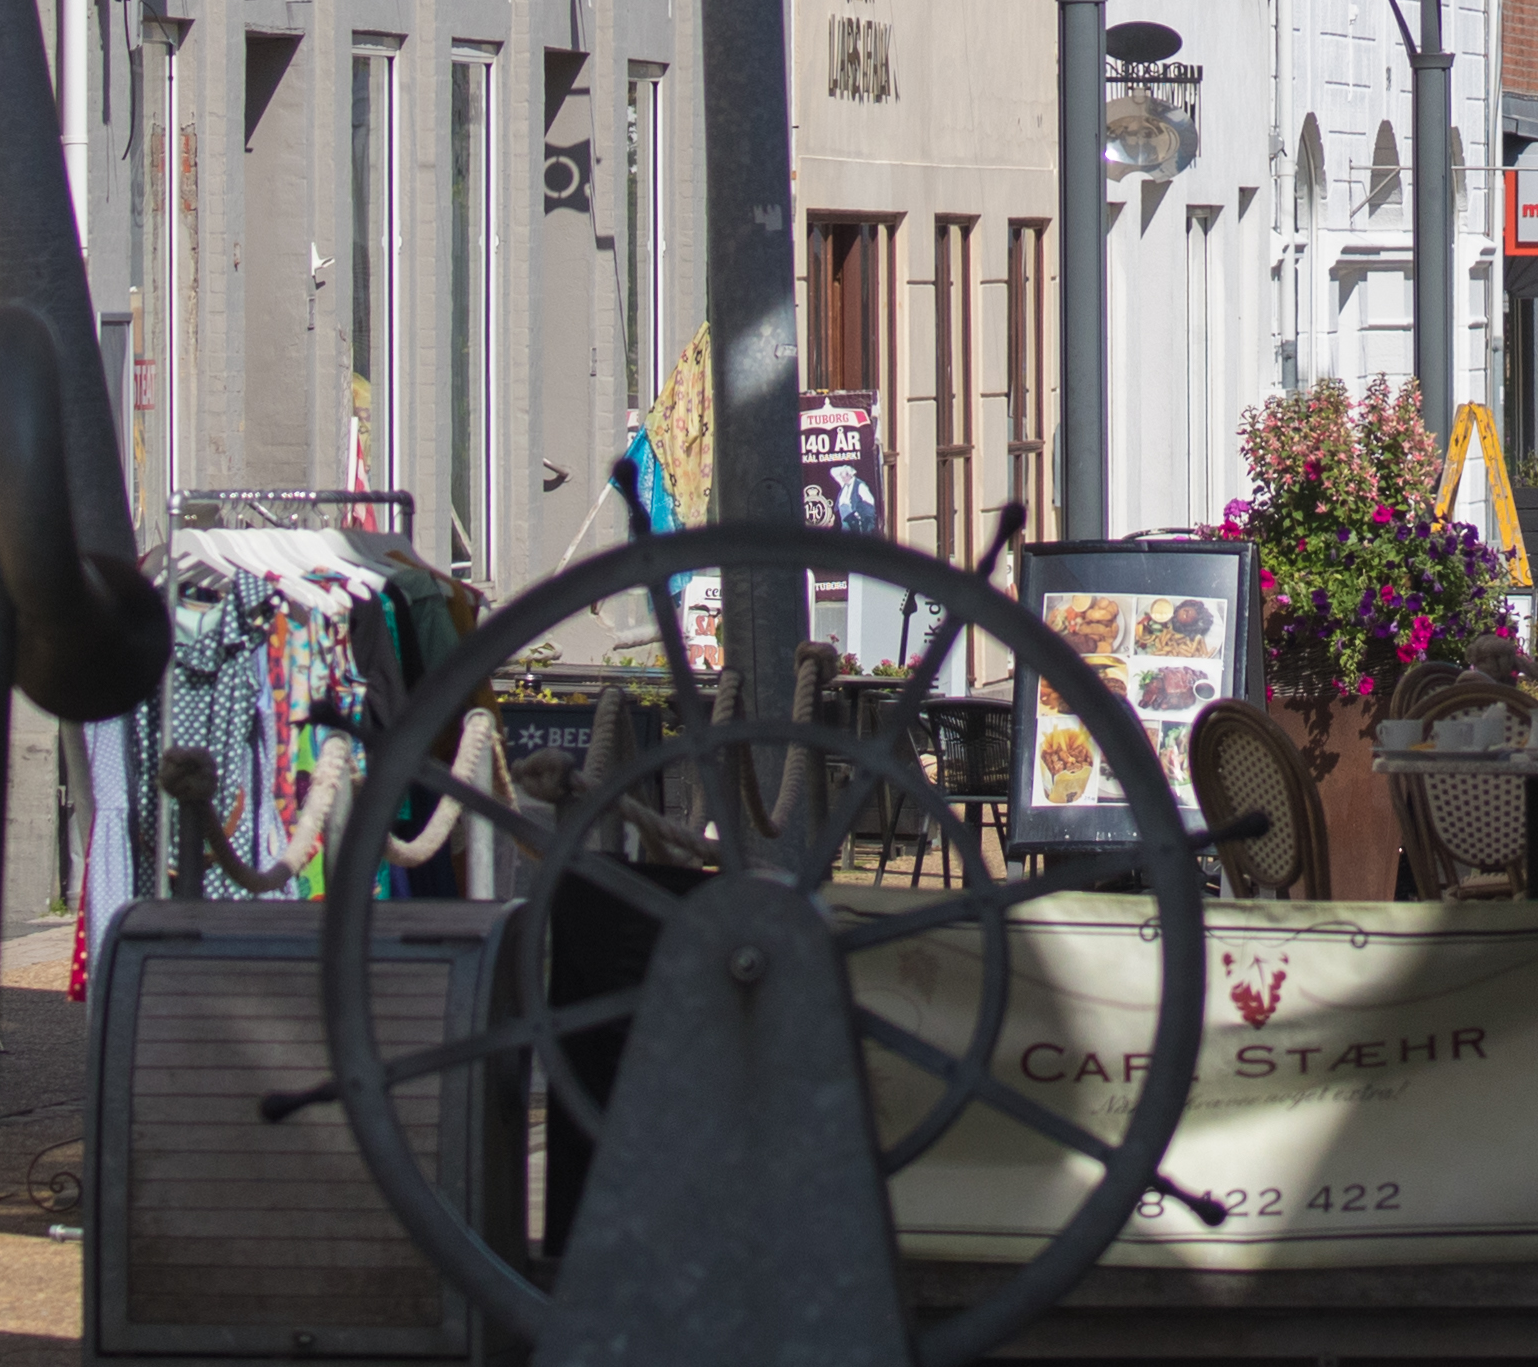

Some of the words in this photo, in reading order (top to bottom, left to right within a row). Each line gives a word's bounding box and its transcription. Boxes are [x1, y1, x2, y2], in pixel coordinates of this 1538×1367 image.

[808, 413, 850, 426] TUBORG
[835, 426, 862, 451] ÅR
[815, 581, 847, 592] TUBORG
[547, 727, 592, 748] BEE
[1020, 1042, 1200, 1083] CAF
[1234, 1027, 1488, 1078] STÆHR
[1307, 1182, 1401, 1212] 422
